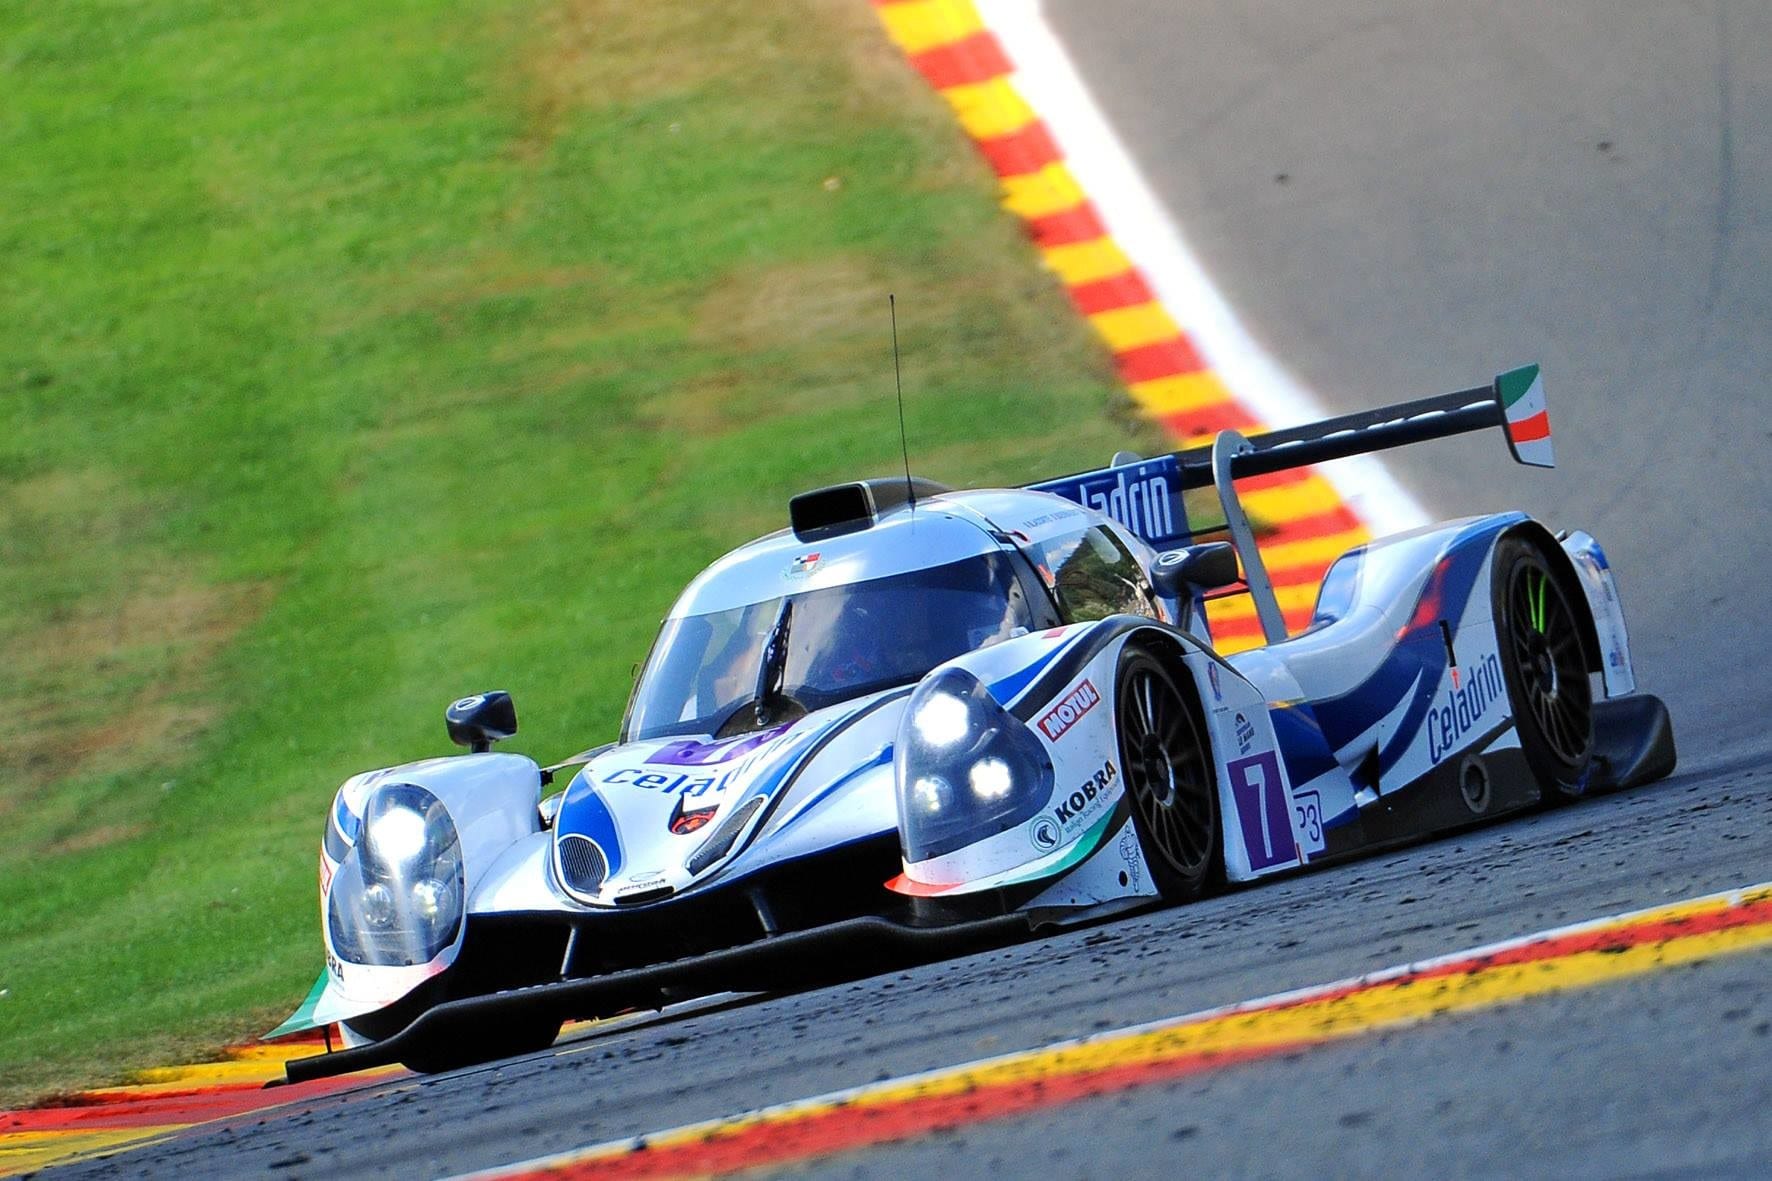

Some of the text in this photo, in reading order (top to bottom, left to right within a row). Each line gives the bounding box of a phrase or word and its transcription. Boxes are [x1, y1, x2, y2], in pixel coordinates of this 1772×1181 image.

[1043, 683, 1098, 738] MOTUL
[1427, 653, 1503, 765] Celadrin
[1054, 760, 1117, 825] KOBRA
[1243, 763, 1273, 859] 7
